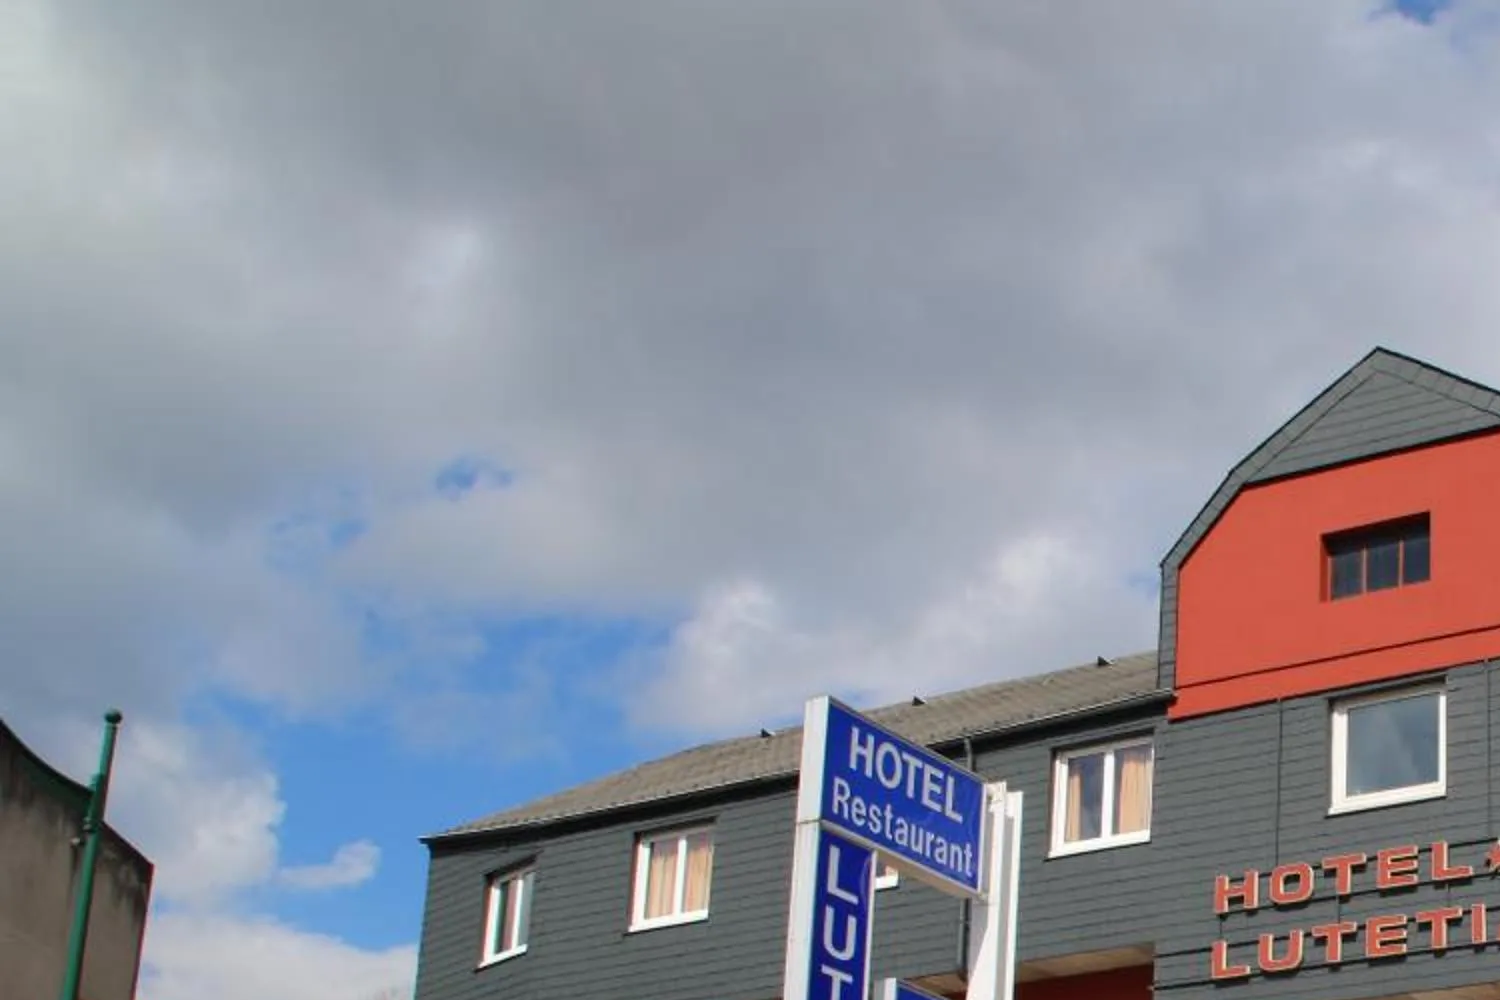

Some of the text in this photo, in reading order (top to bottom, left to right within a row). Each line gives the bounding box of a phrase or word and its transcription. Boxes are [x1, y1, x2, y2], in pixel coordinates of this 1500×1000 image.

[848, 726, 964, 824] HOTEL
[831, 775, 974, 877] Restaurant
[1213, 840, 1474, 915] HOTEL
